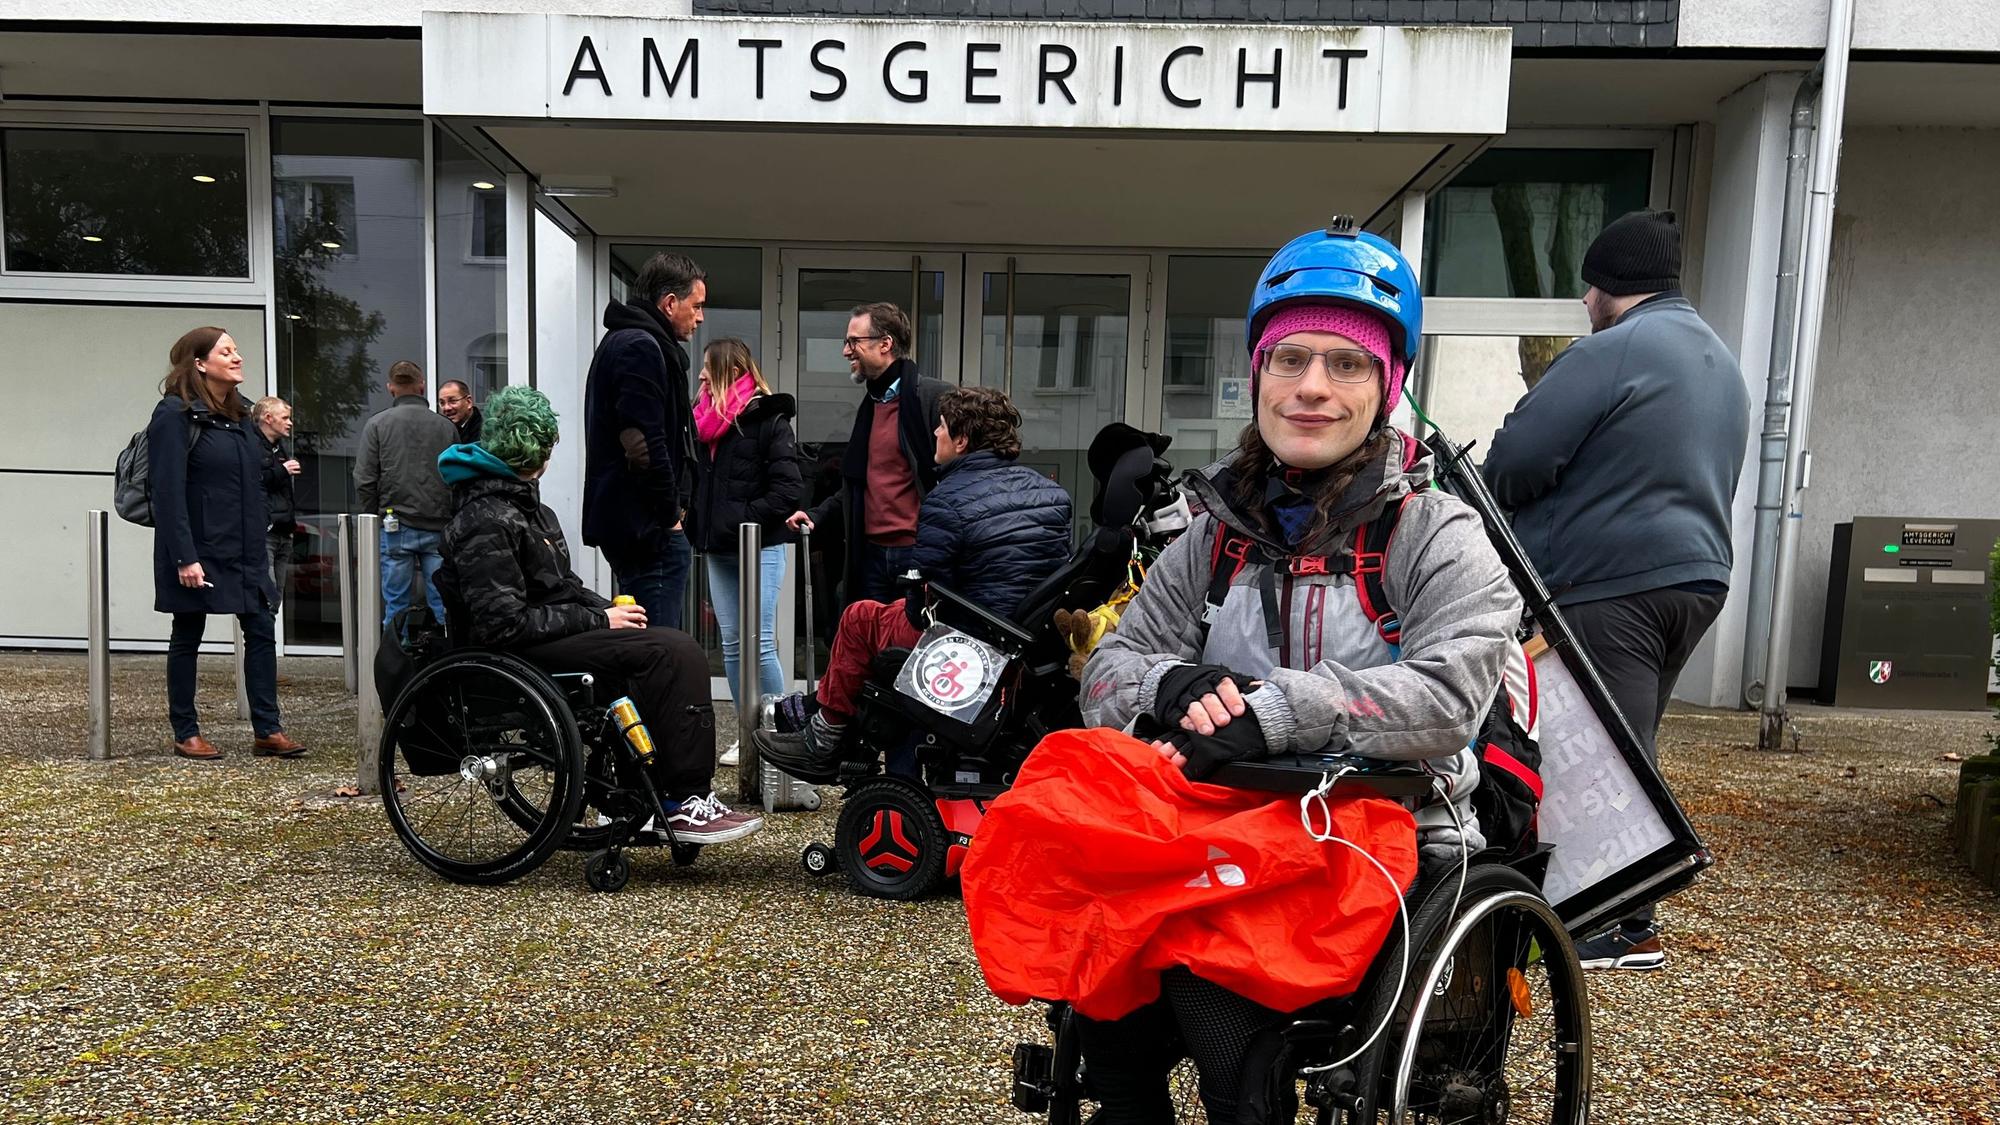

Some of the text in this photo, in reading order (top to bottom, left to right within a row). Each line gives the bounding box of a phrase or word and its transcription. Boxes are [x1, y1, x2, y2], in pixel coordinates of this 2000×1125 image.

[563, 36, 1368, 109] AMTSGERICHT
[1904, 531, 1954, 539] AMTSGERICHT
[921, 688, 945, 706] ACTION
